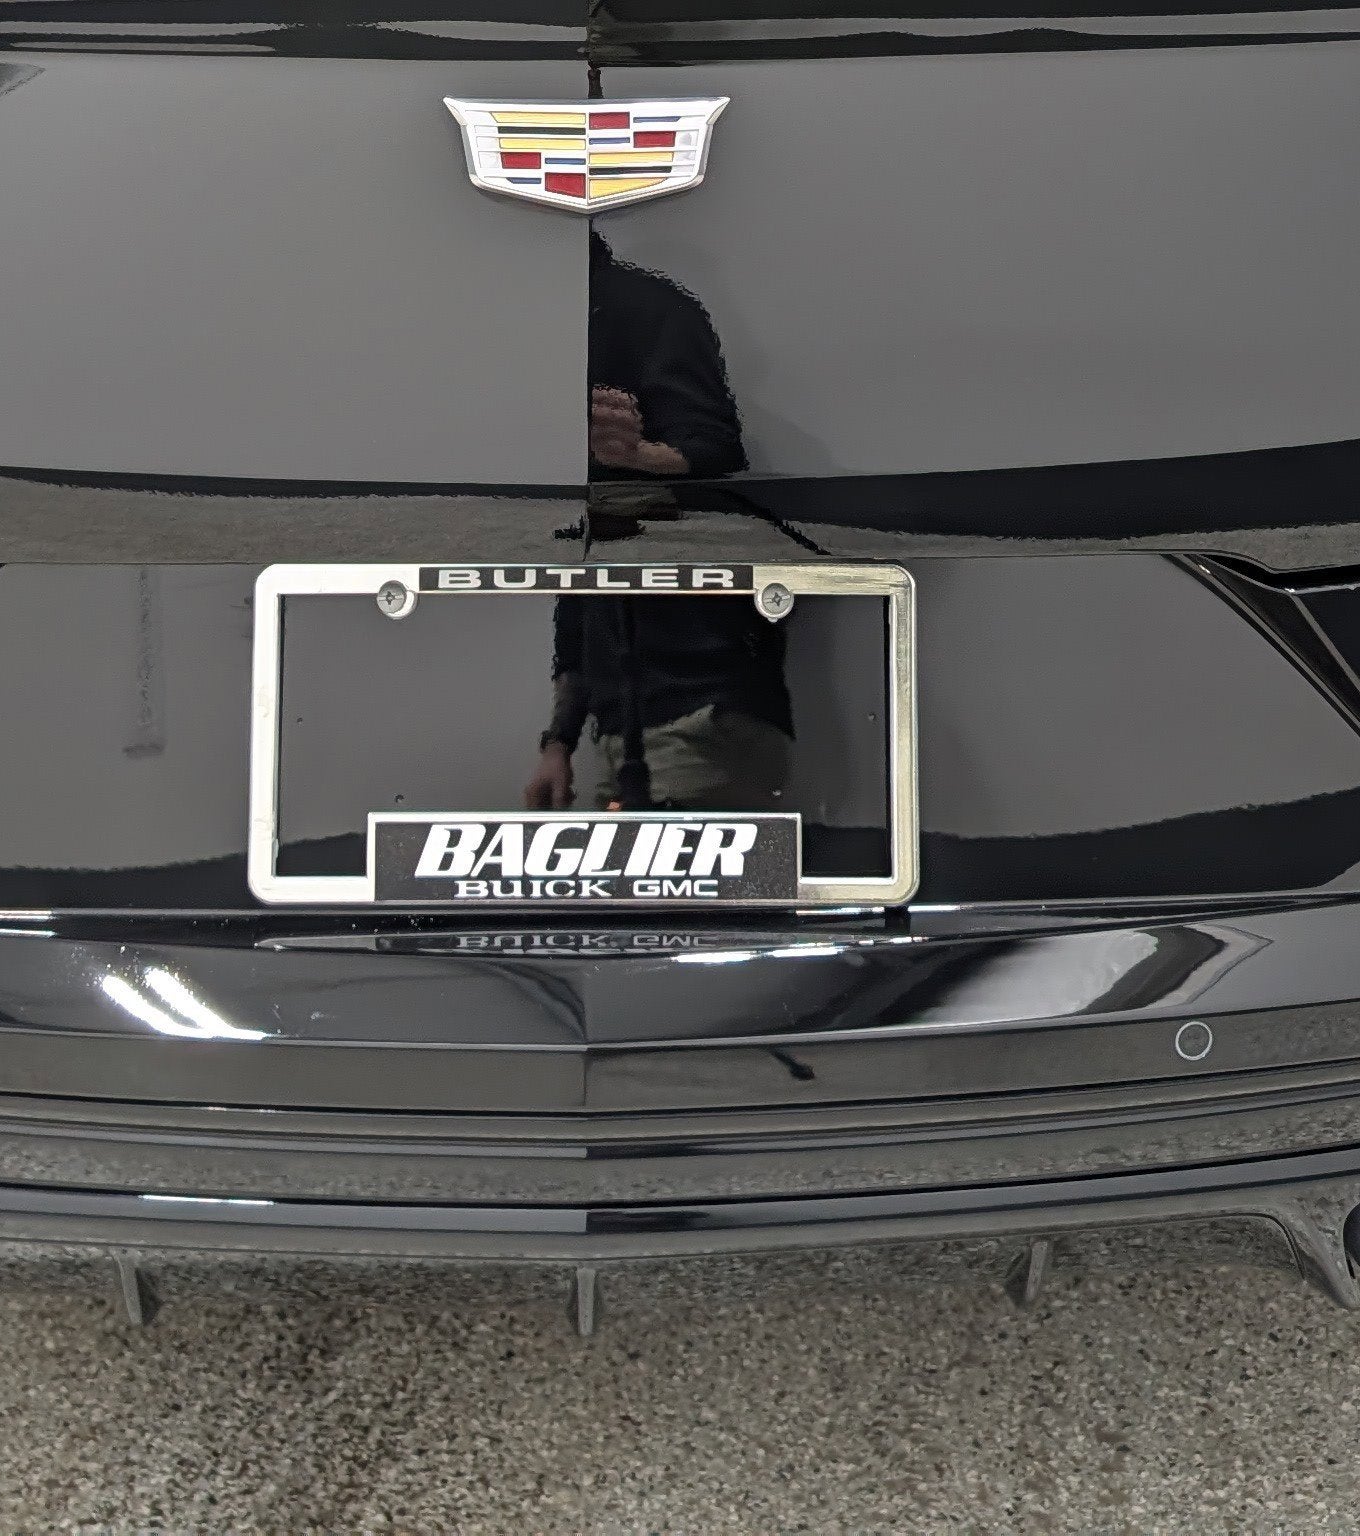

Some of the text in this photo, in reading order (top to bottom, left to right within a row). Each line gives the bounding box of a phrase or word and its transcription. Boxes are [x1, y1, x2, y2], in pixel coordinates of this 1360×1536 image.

[437, 568, 735, 589] BUTLER
[413, 822, 758, 878] BAGLIER
[453, 879, 719, 899] BUICK GMC
